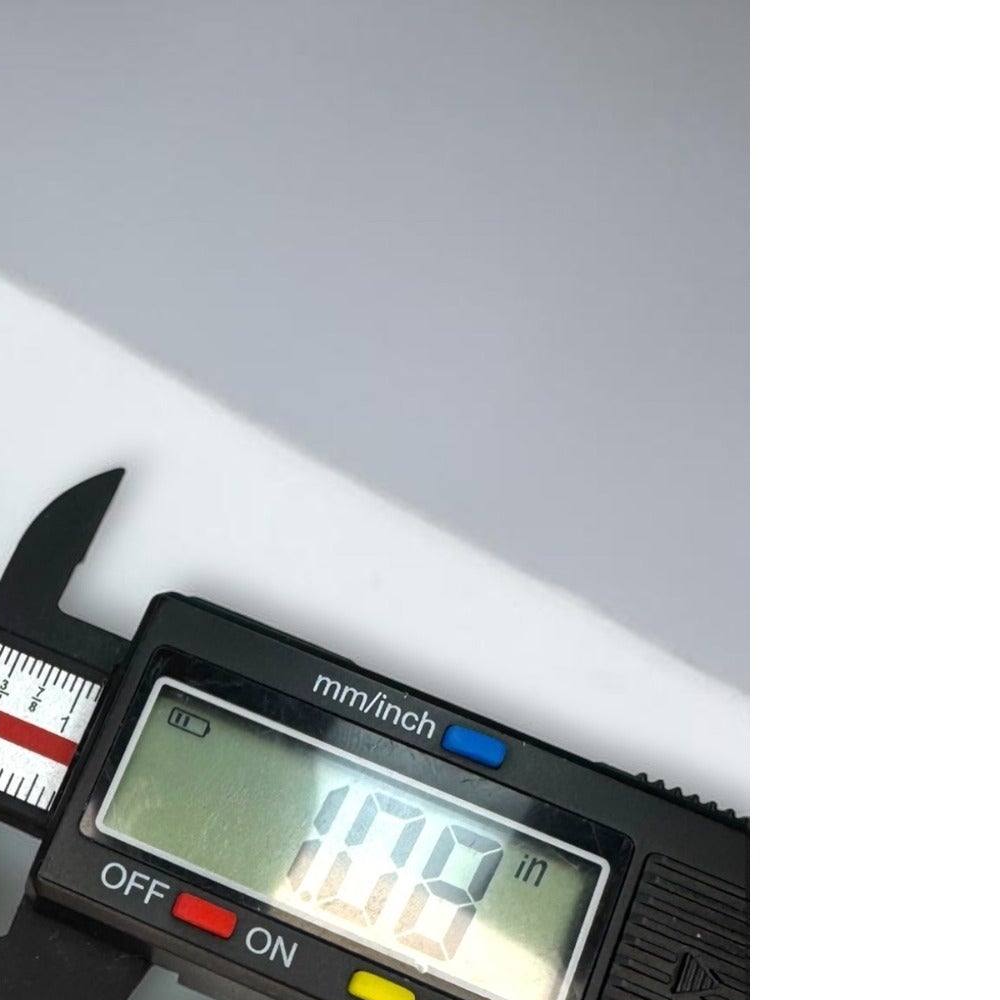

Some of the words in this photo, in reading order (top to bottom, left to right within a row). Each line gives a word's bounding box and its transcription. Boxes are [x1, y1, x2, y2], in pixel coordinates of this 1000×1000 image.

[312, 673, 436, 739] mm/inch
[100, 862, 171, 905] OFF
[286, 784, 504, 961] 1.08
[514, 852, 549, 888] in
[245, 927, 298, 968] ON
